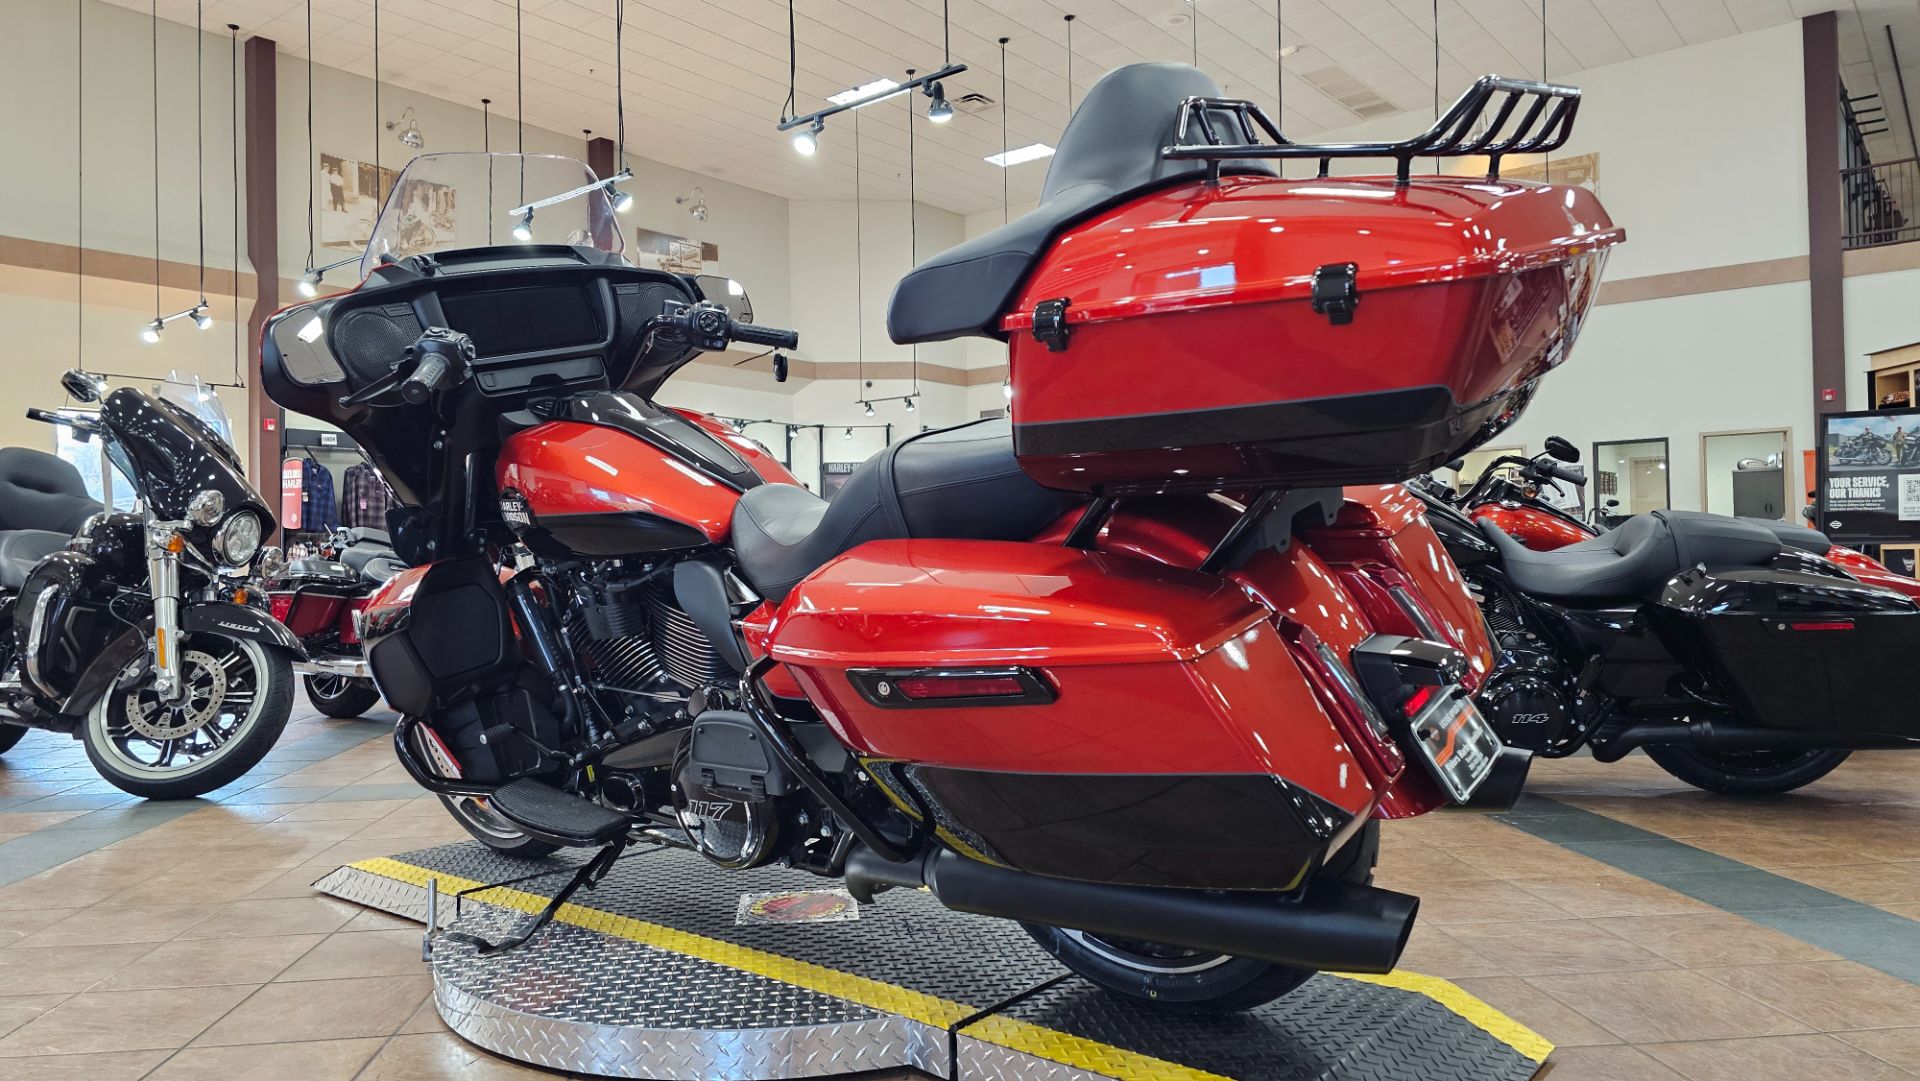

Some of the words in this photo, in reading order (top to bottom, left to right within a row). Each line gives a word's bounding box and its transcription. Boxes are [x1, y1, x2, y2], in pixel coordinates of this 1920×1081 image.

[1829, 477, 1851, 488] YOUR
[1852, 476, 1889, 488] SERVICE,
[1829, 488, 1846, 499] OUR
[1847, 487, 1881, 498] THANKS
[1511, 713, 1550, 724] 114
[688, 800, 733, 821] 117
